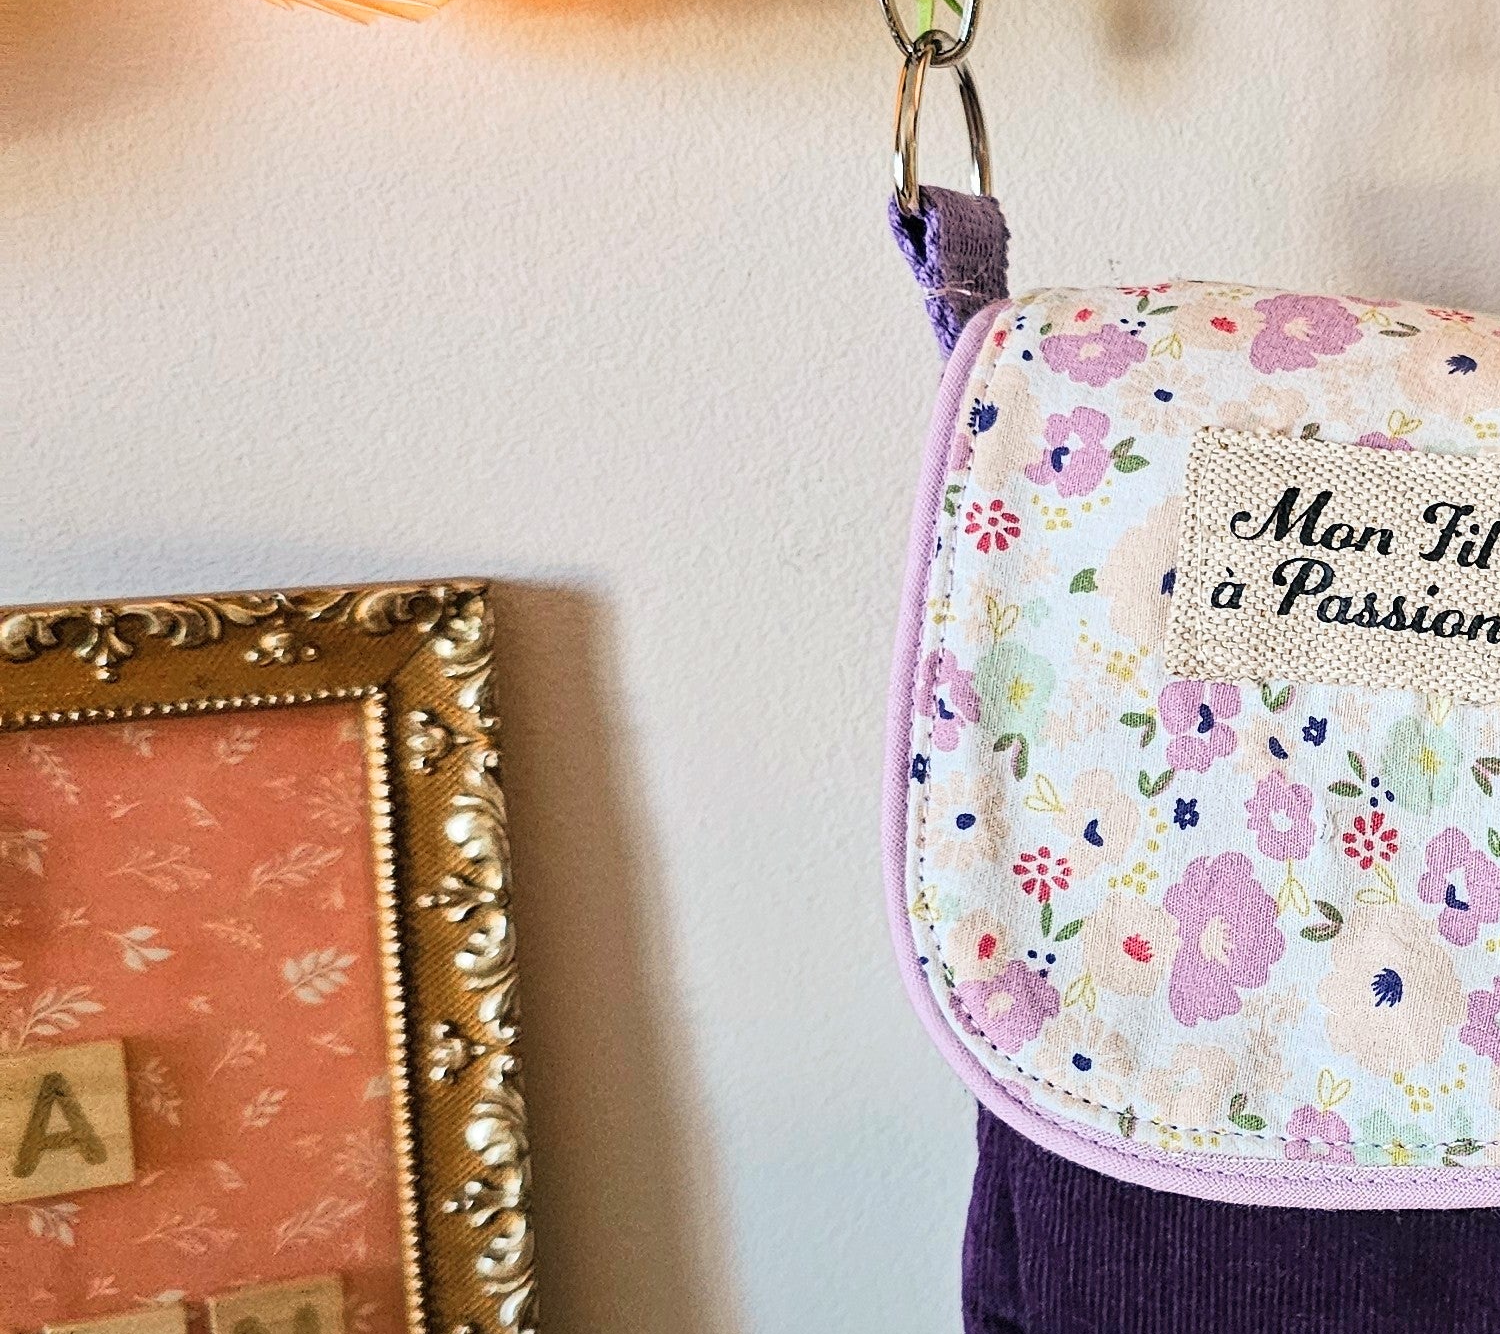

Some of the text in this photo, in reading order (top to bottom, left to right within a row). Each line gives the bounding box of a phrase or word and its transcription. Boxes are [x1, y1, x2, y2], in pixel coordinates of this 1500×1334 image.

[1230, 487, 1394, 556] Mon
[1210, 566, 1247, 610] à
[13, 1071, 108, 1179] A
